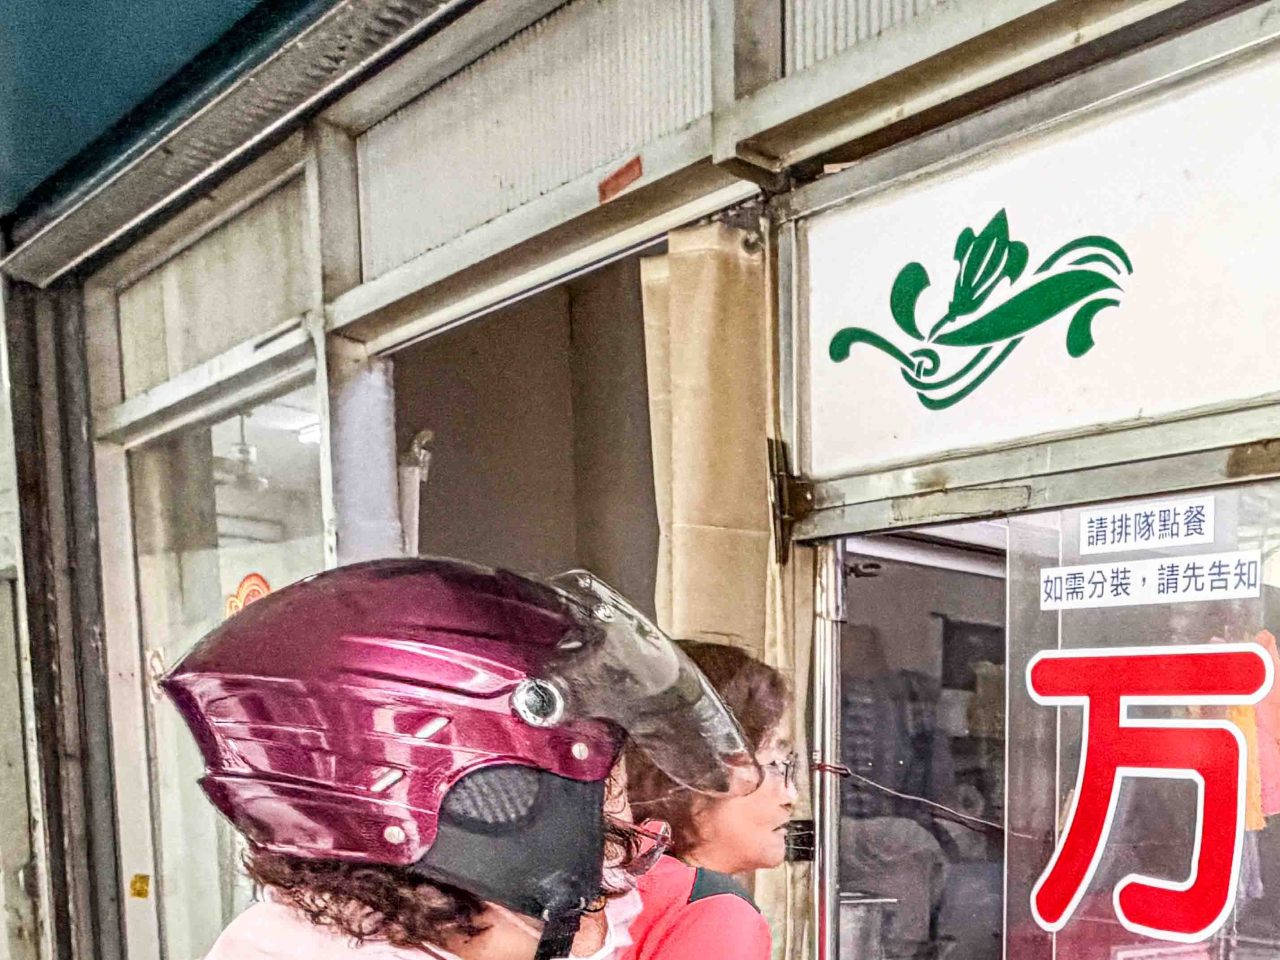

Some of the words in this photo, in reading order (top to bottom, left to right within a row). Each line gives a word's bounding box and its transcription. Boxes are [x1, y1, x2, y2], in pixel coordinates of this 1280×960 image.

[1087, 506, 1206, 547] 請排隊點餐
[1043, 557, 1258, 601] 如需分裝，請先告知
[1026, 642, 1274, 943] 万
